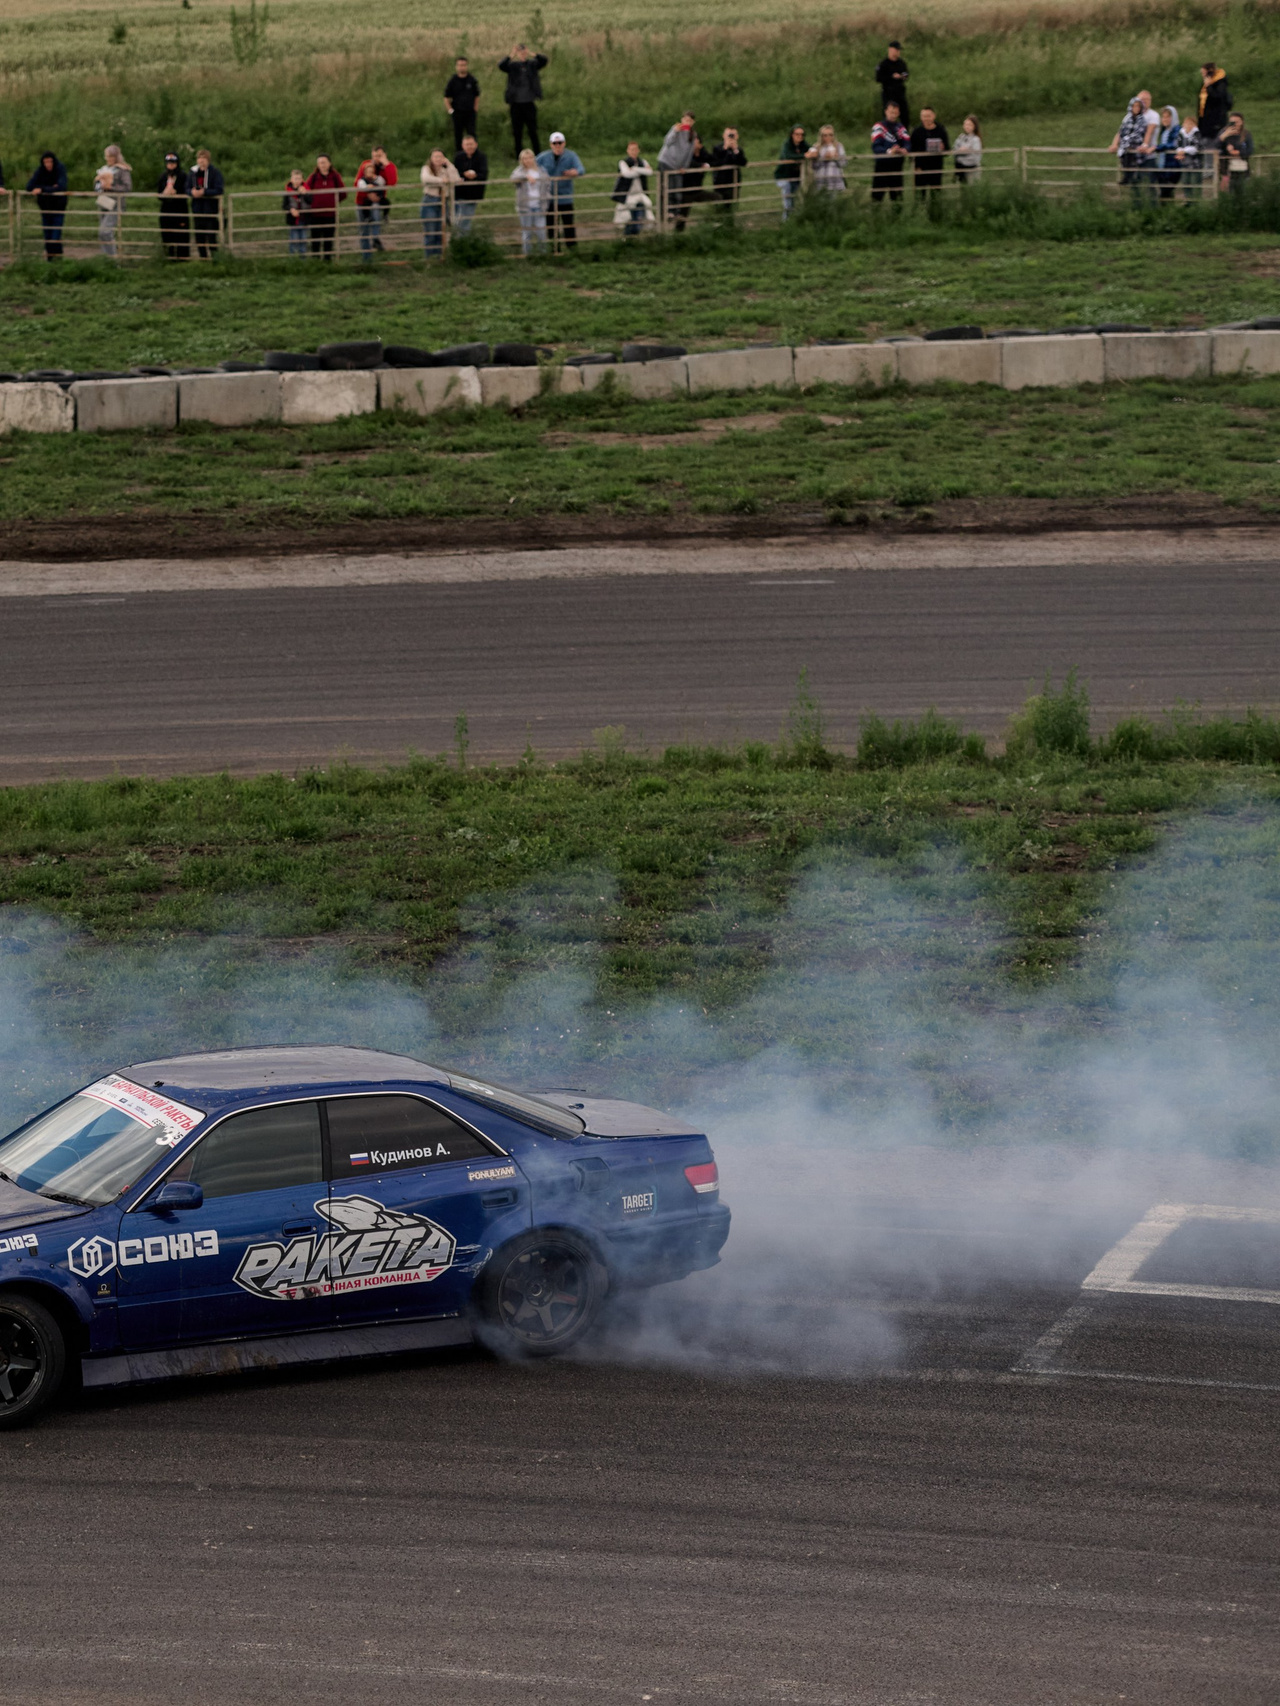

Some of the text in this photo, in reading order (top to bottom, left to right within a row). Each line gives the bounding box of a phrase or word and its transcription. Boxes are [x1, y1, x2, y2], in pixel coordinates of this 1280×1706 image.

[370, 1143, 451, 1166] Кудинов А.
[468, 1166, 514, 1181] PONULYAM
[621, 1192, 654, 1209] TARGET
[118, 1229, 219, 1266] СОЮЗ
[239, 1225, 454, 1290] РАКЕТА
[364, 1271, 421, 1287] КОМАНДА
